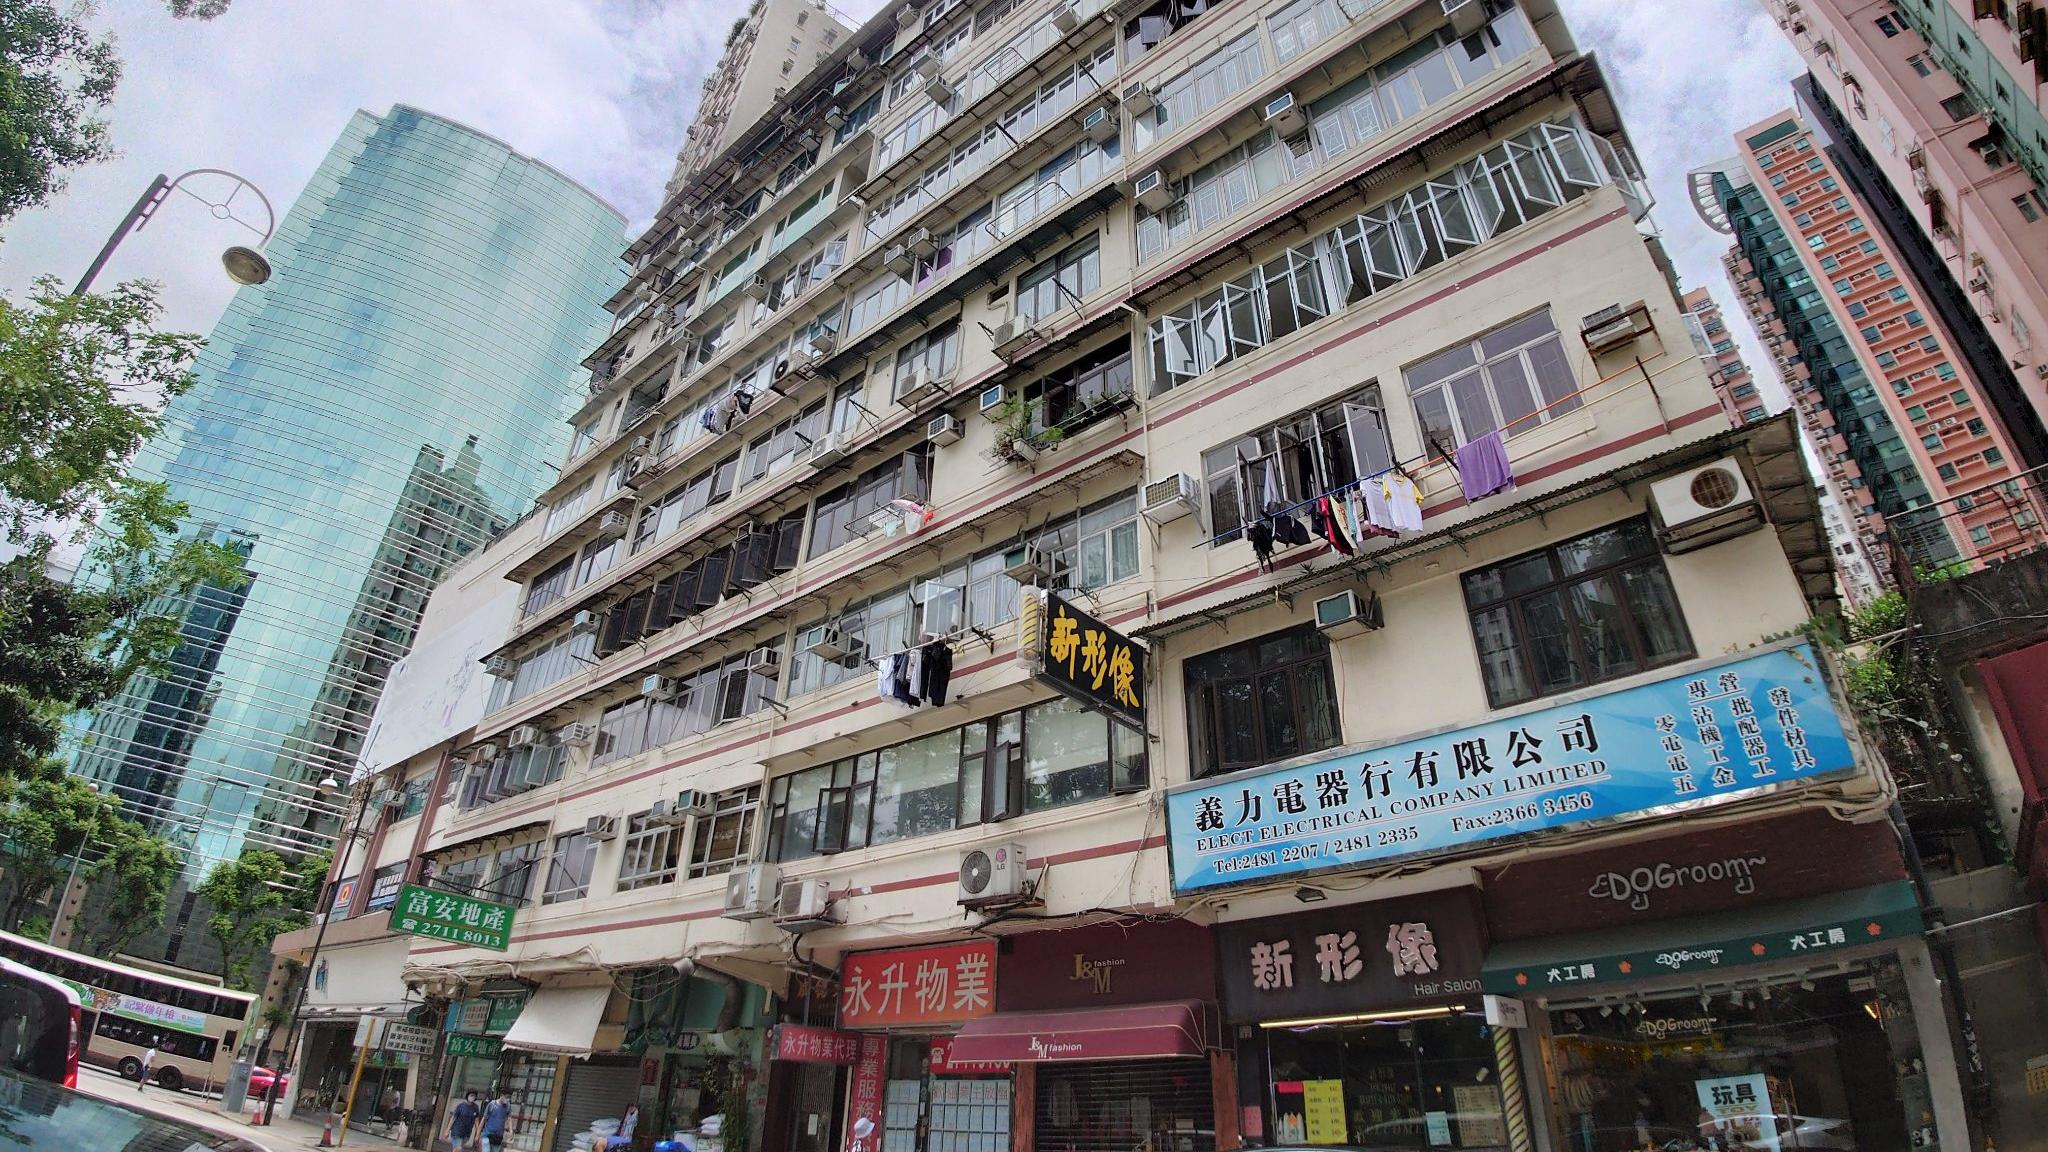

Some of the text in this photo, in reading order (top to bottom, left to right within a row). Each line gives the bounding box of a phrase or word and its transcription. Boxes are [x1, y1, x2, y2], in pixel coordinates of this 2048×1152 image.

[1050, 605, 1140, 708] 新形像
[1687, 672, 1740, 698] 專營
[1195, 714, 1599, 832] 義力電器行有限公司
[1196, 760, 1606, 851] ELECT ELECTRICAL COMPANY LIMITED
[1451, 792, 1593, 832] Fax:2366 3456
[1213, 851, 1276, 874] Tel:2481
[1282, 843, 1319, 862] 2207
[1334, 835, 1372, 853] 2481
[1378, 826, 1419, 846] 2335
[997, 863, 1005, 871] LG
[407, 891, 506, 931] 富安地產
[421, 922, 501, 947] 2711 8013
[1790, 927, 1846, 950] 犬工房
[1094, 959, 1125, 967] fashion
[1251, 922, 1439, 990] 新形像
[842, 953, 989, 1016] 永升物業
[1414, 978, 1482, 997] Hair Salon
[1547, 964, 1595, 983] 犬工房
[784, 1032, 857, 1061] 永升物業代理
[1049, 1043, 1082, 1053] fashion
[854, 1037, 881, 1150] 專業服務
[1711, 1083, 1757, 1105] 玩具
